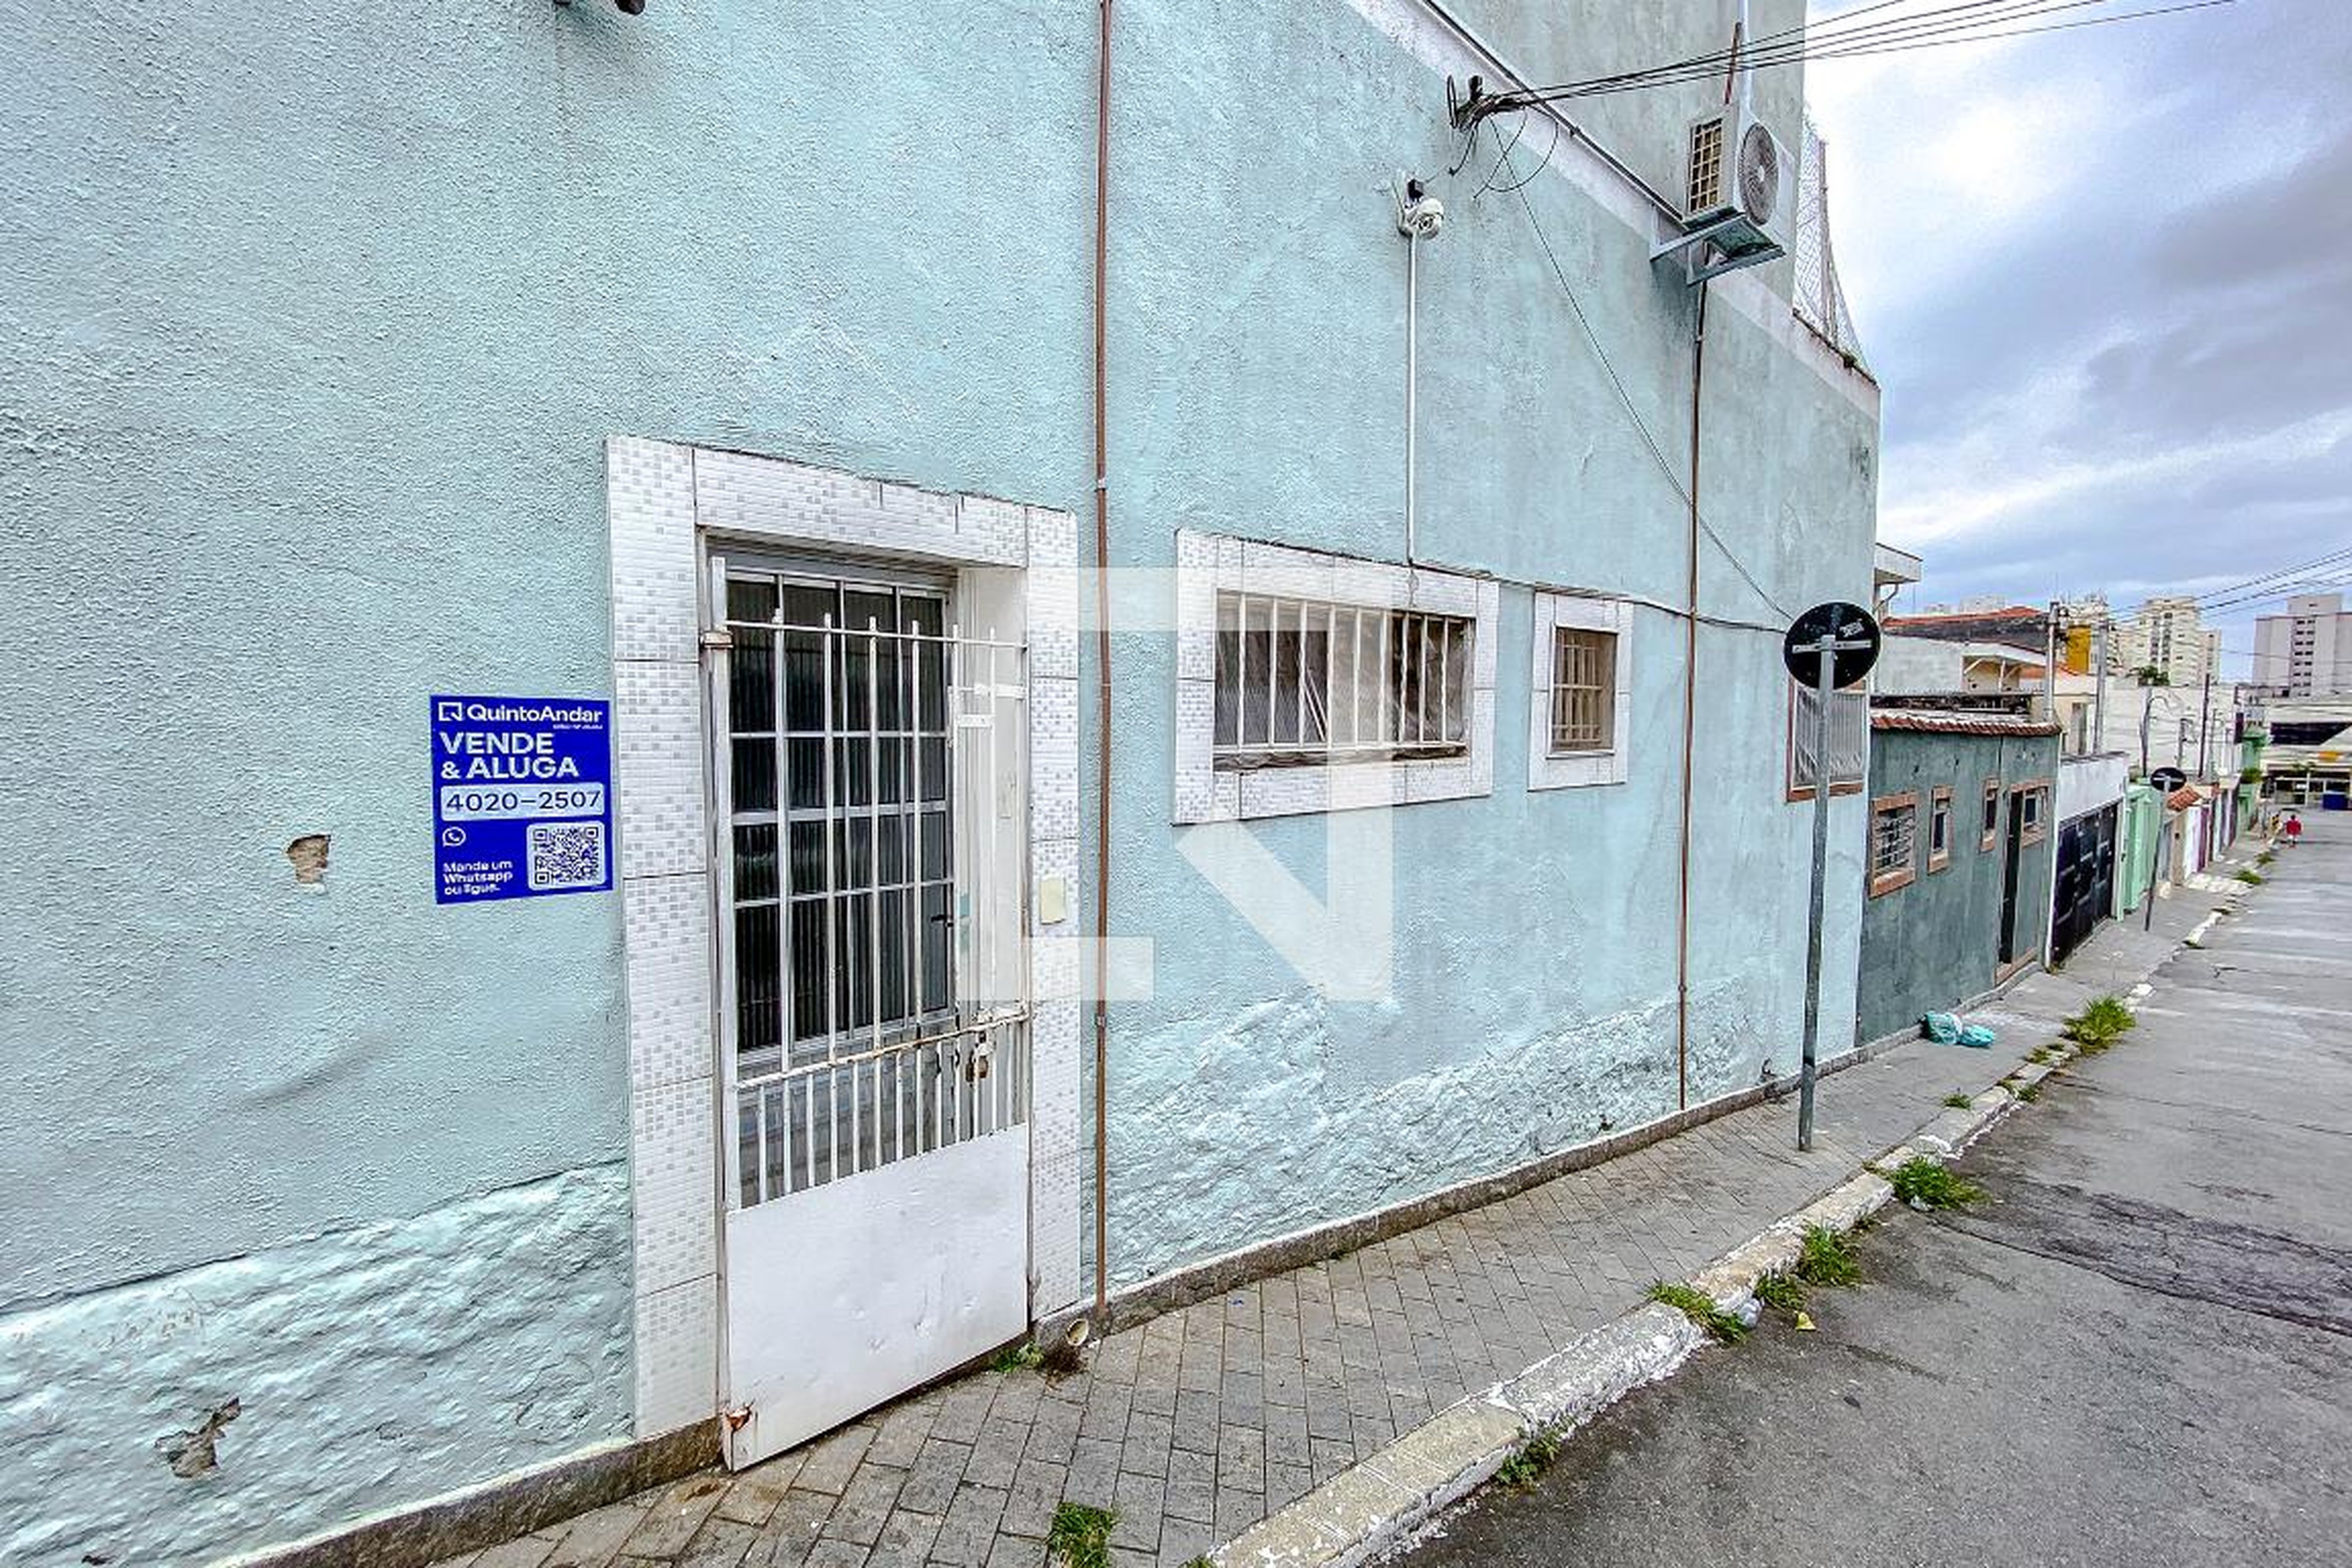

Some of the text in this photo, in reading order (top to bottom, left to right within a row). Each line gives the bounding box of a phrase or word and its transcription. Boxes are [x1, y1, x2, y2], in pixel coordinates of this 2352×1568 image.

[467, 704, 603, 722] QuintoAndar
[439, 731, 555, 754] VENDE
[441, 756, 579, 779] & ALUGA
[447, 790, 601, 811] 4020-2507
[491, 861, 513, 870] um
[444, 886, 462, 895] ou
